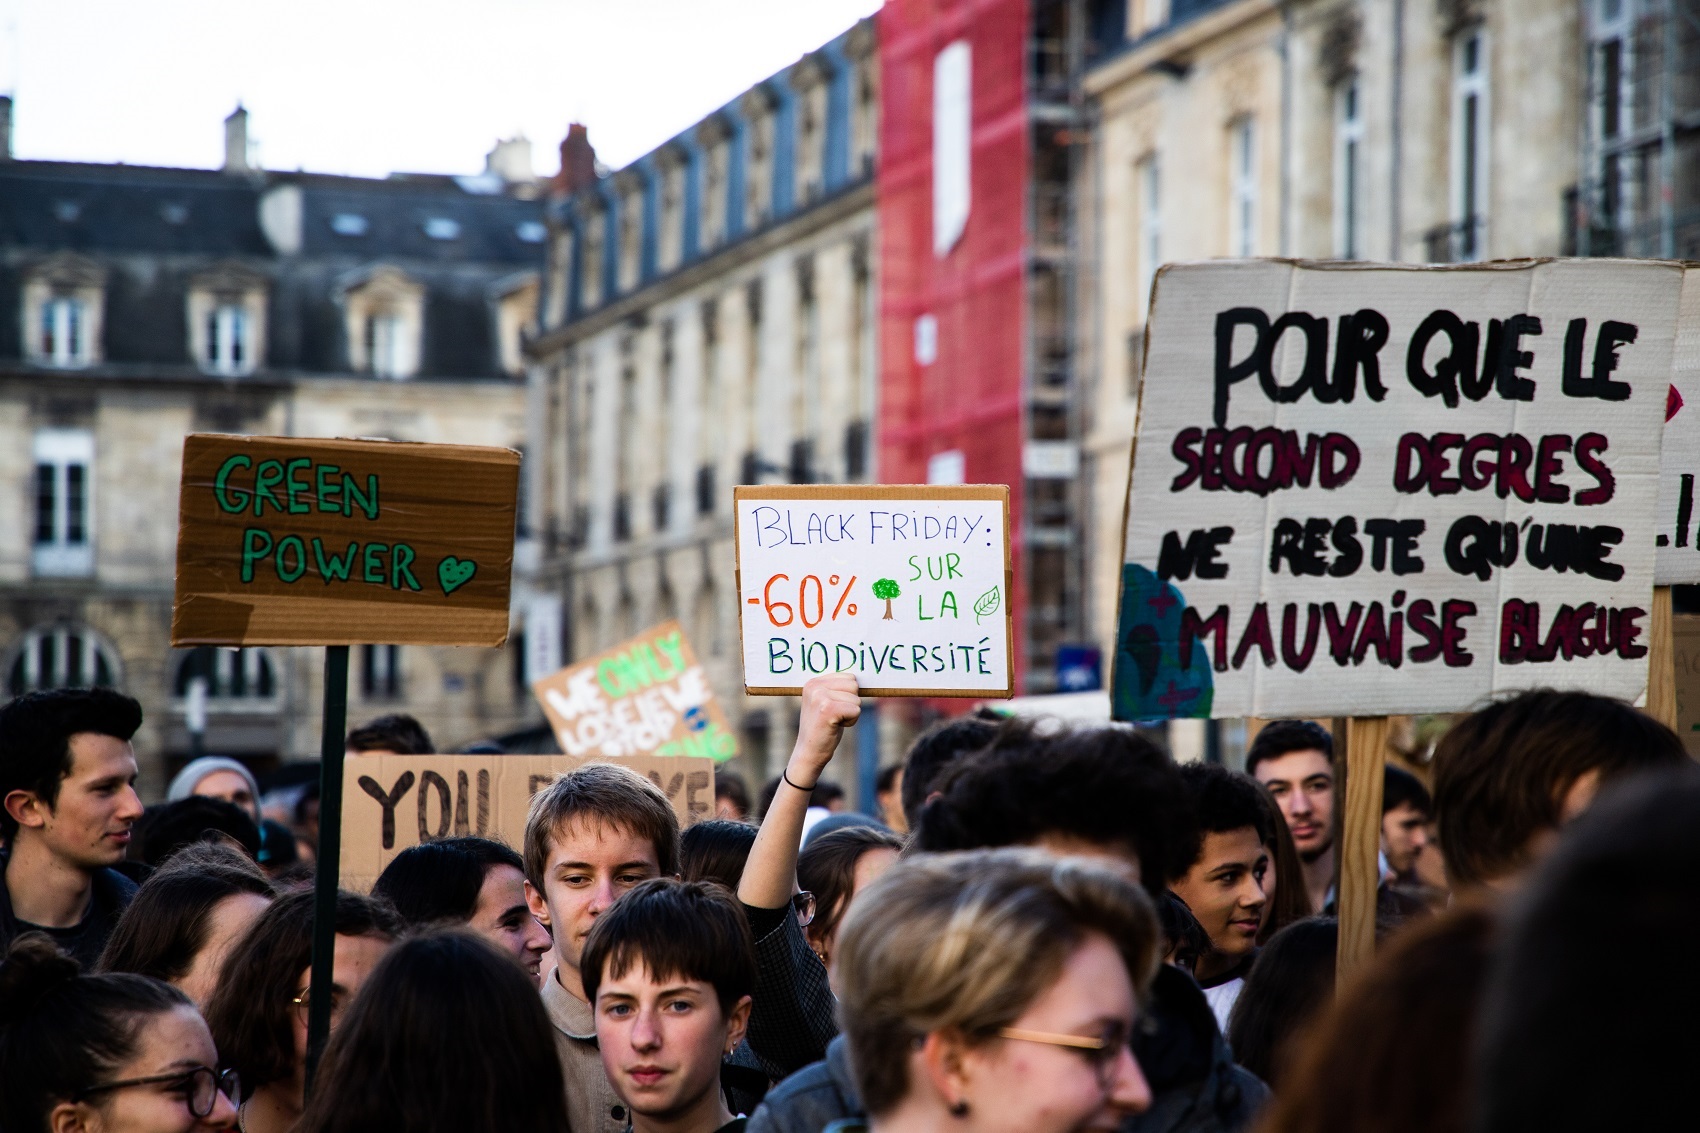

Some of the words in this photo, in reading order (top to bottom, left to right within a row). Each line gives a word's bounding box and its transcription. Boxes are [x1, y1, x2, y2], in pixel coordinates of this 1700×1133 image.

[1212, 307, 1390, 426] POUR
[1407, 309, 1543, 408] QUE
[1562, 317, 1640, 401] LE
[214, 454, 380, 520] GREEN
[1170, 426, 1361, 496] SECOND
[1394, 431, 1617, 505] DEGRES
[240, 528, 423, 592] POWER
[752, 506, 855, 548] BLACK
[1156, 526, 1236, 581] NE
[1270, 516, 1426, 577] RESTE
[1444, 515, 1625, 581] QU'UNE
[908, 552, 963, 582] SUR
[747, 573, 858, 629] -60%
[917, 590, 959, 621] LA
[1499, 598, 1649, 664] BLAGUE
[544, 666, 601, 720] WE
[597, 631, 687, 698] ONLY
[661, 665, 713, 711] WE
[357, 769, 490, 849] YOU
